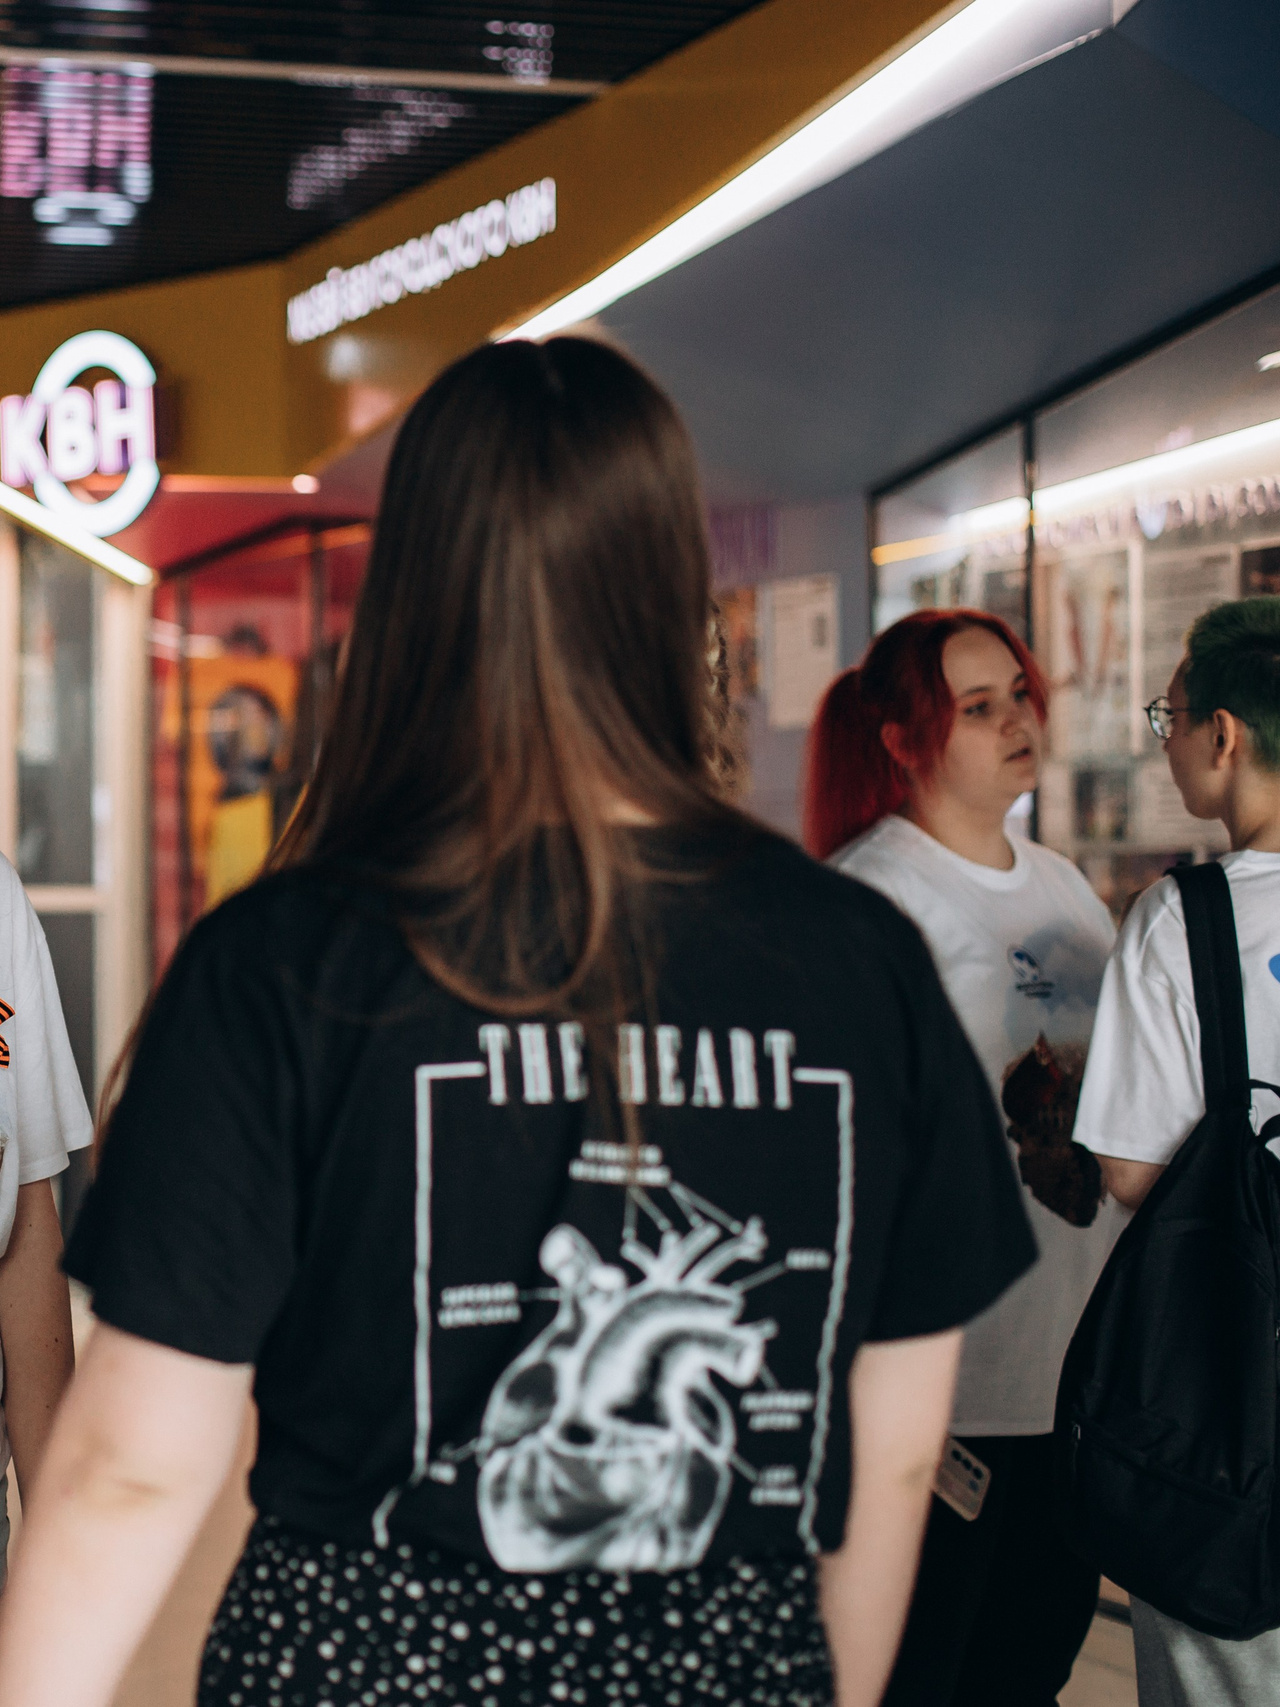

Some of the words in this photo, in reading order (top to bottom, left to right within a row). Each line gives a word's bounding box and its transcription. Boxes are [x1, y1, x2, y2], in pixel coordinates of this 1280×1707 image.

[0, 378, 156, 488] КВН
[478, 1022, 589, 1105] THE
[618, 1022, 796, 1110] HEART
